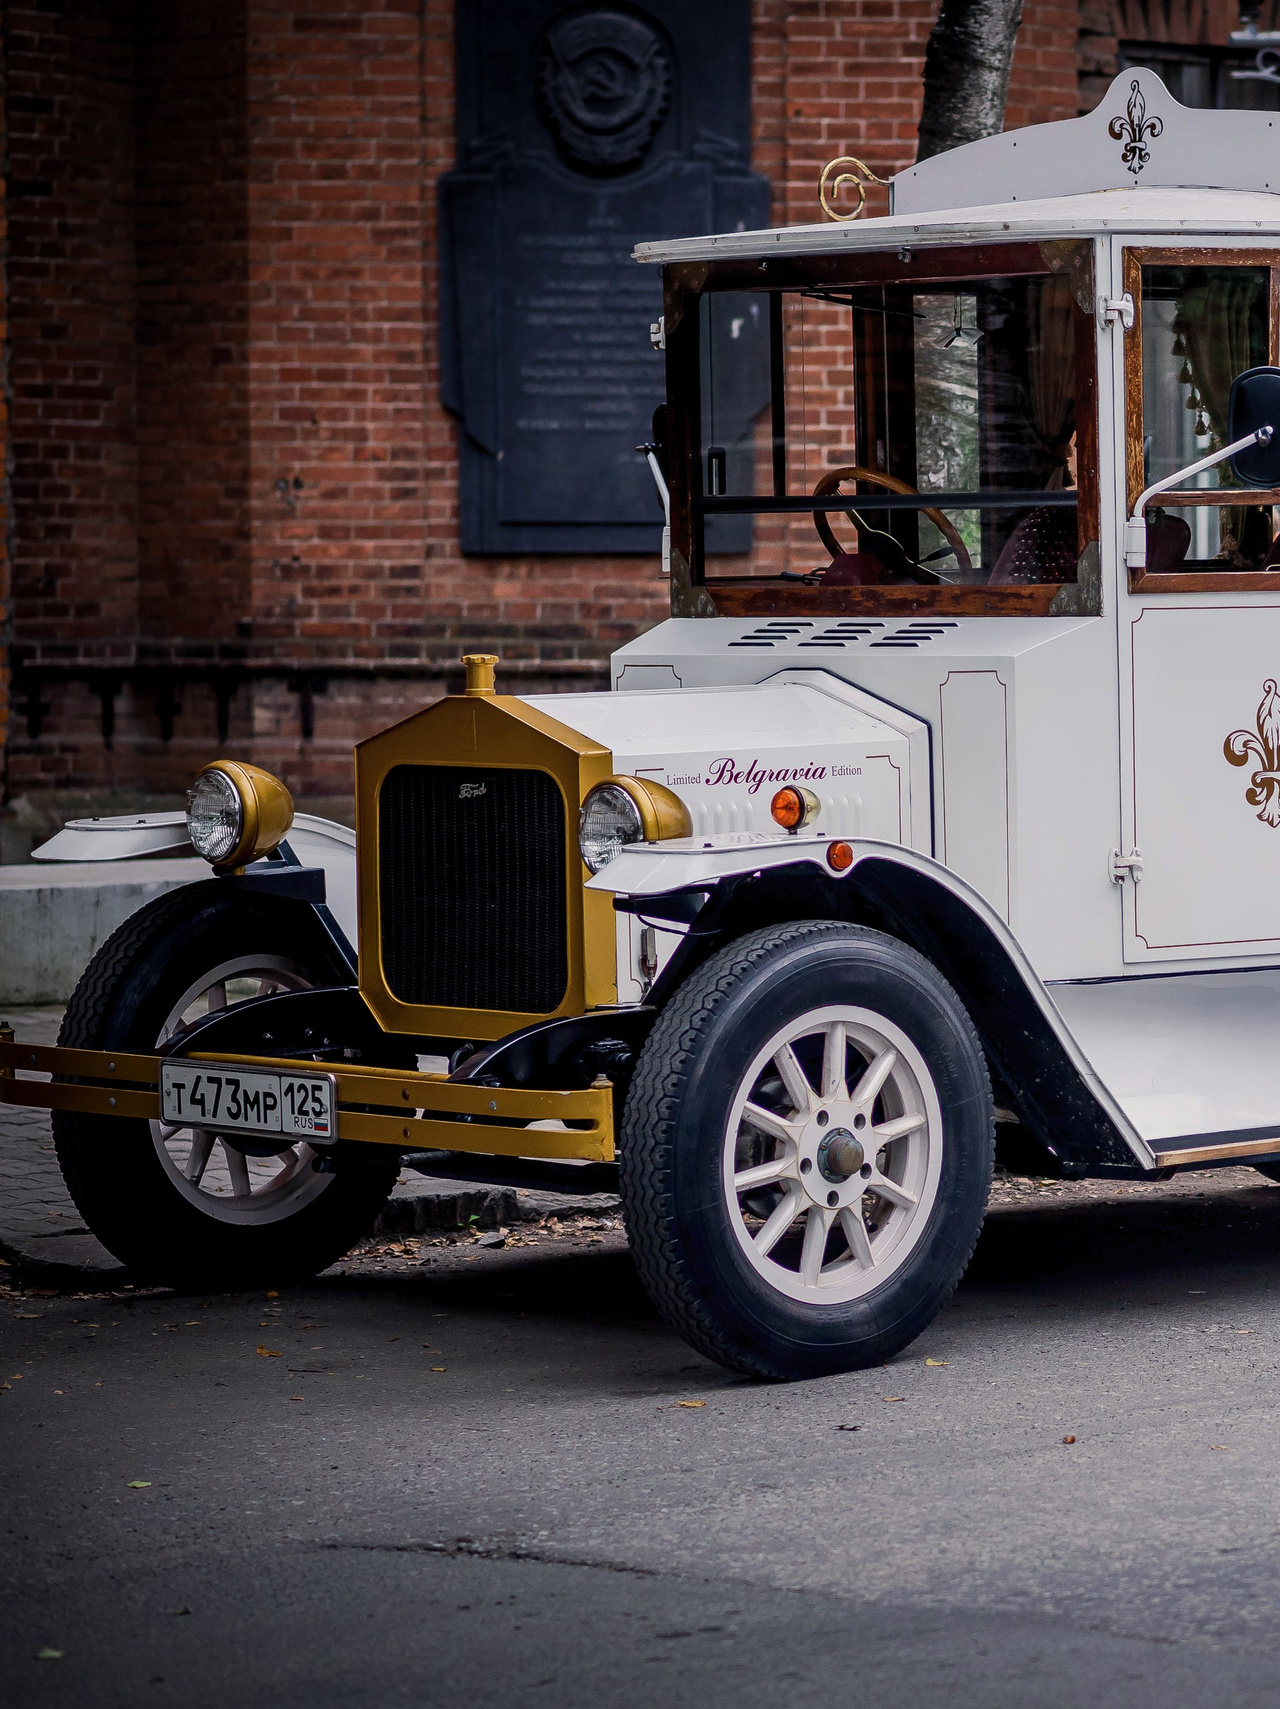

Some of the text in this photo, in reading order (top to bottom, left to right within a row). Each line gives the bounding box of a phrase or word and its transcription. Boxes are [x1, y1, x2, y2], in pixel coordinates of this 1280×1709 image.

[666, 757, 862, 795] Limited Belgravia Edition
[458, 782, 487, 799] Ford
[283, 1082, 324, 1117] 125
[293, 1117, 314, 1129] RUS
